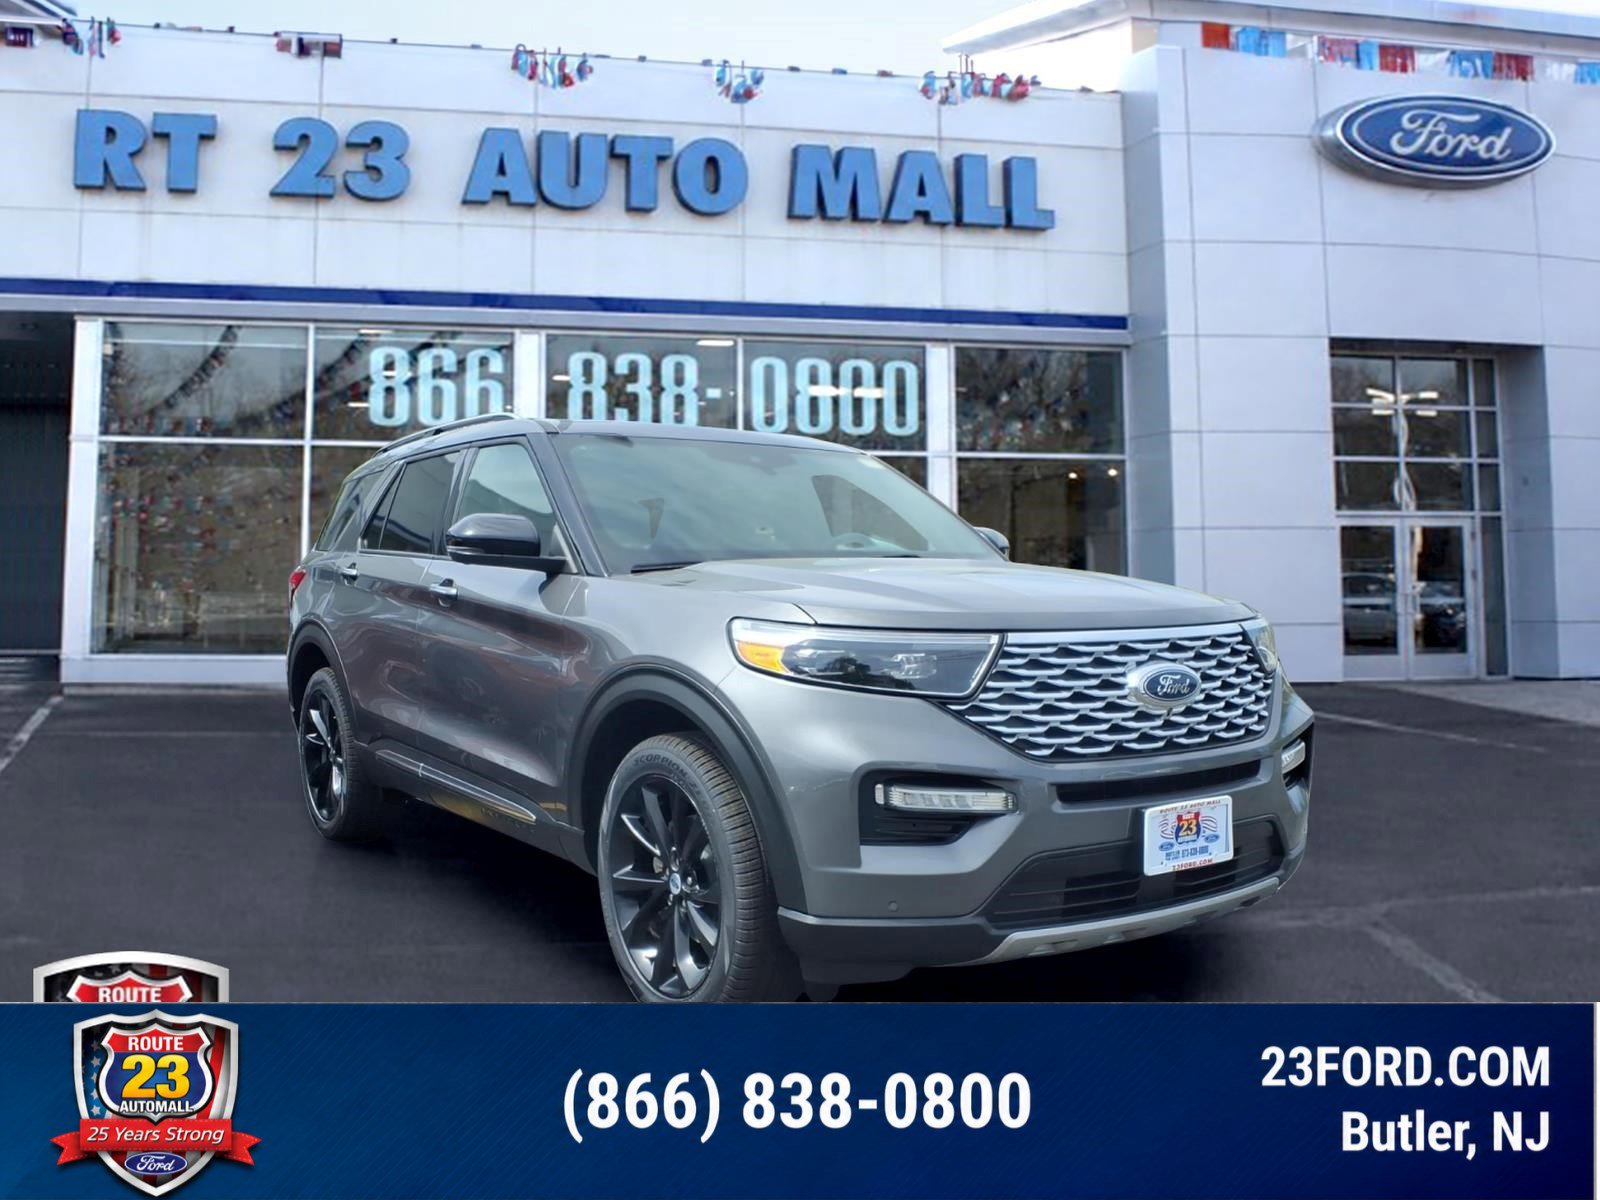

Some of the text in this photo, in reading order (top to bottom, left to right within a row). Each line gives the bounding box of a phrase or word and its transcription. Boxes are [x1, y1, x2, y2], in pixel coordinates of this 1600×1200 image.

[1390, 109, 1511, 160] Ford
[74, 109, 1055, 230] RT 23 AUTO MALL
[369, 346, 504, 426] 866
[1157, 674, 1190, 696] Ford
[1178, 819, 1198, 836] 23
